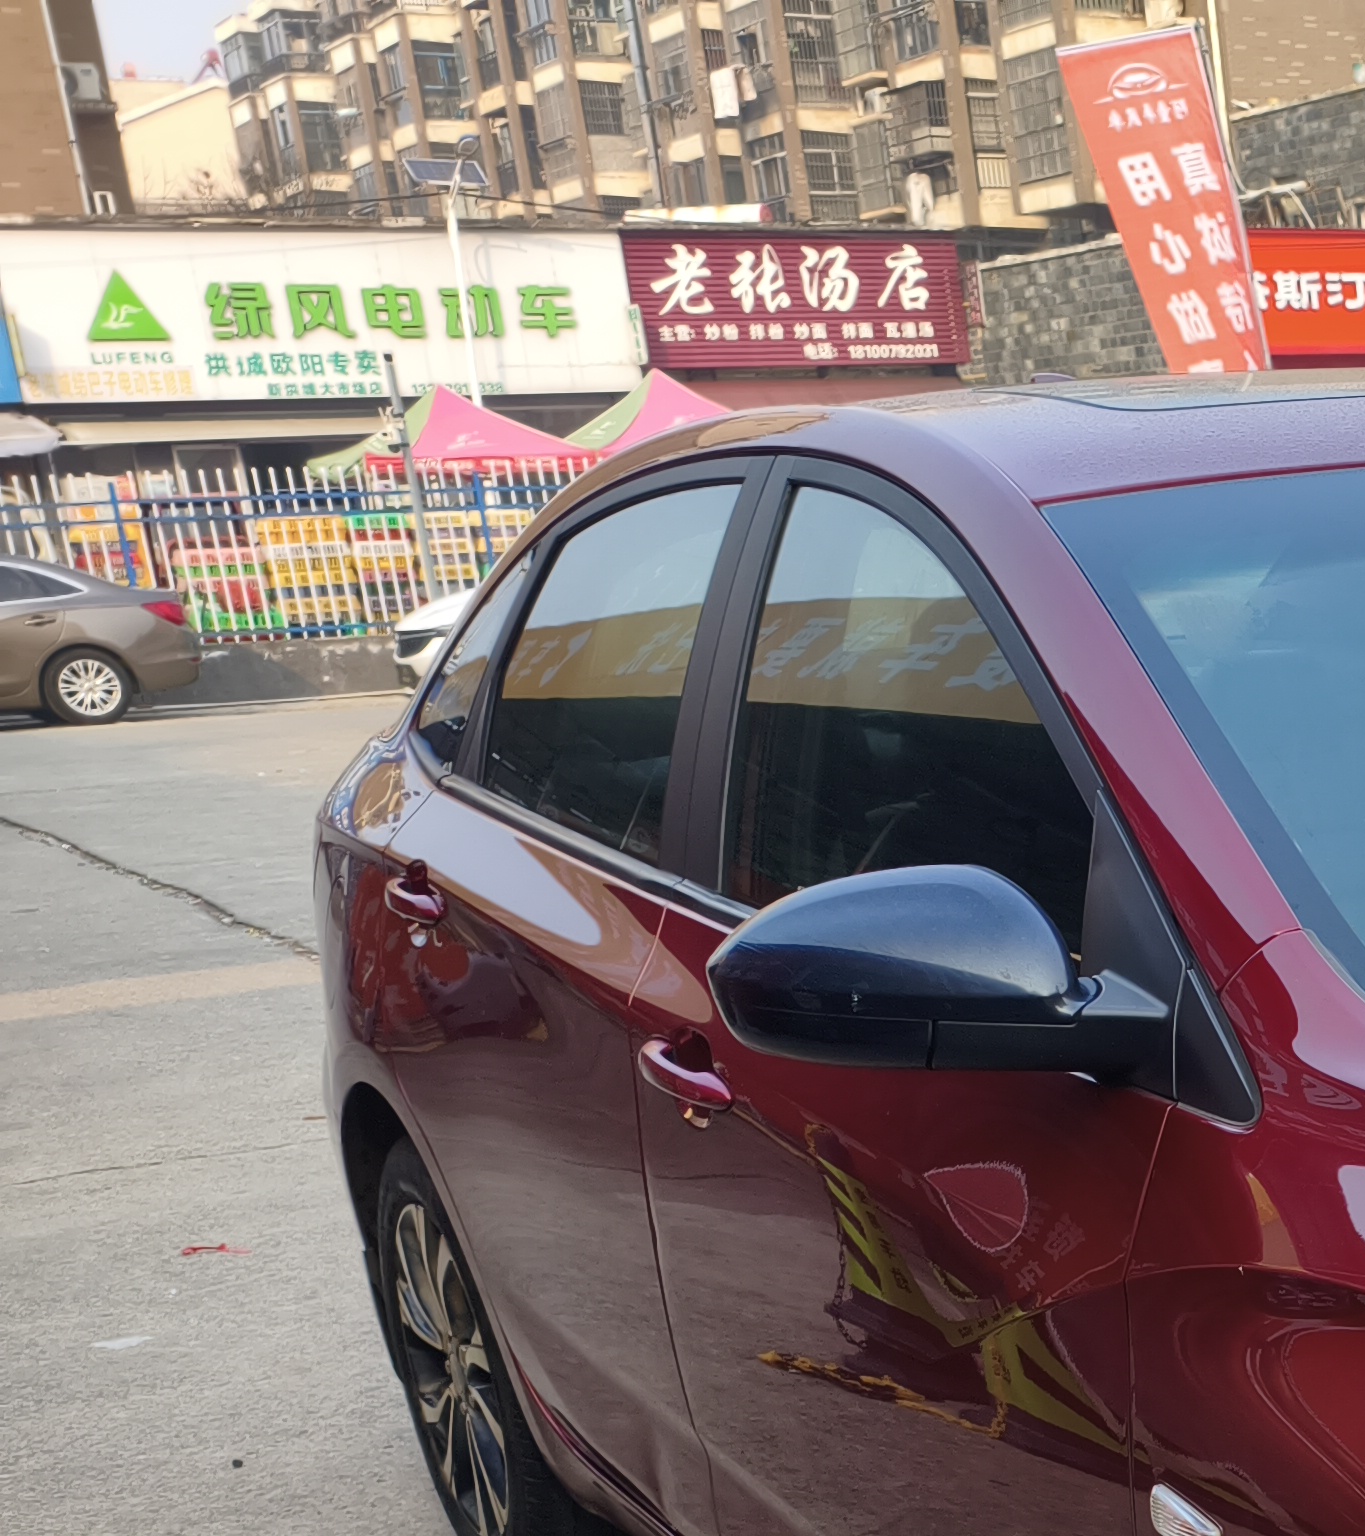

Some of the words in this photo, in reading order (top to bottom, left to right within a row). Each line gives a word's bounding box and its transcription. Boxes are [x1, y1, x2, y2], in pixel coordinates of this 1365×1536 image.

[650, 243, 930, 315] 老张汤店
[204, 282, 578, 341] 绿风电动车
[90, 351, 174, 365] LUFENG
